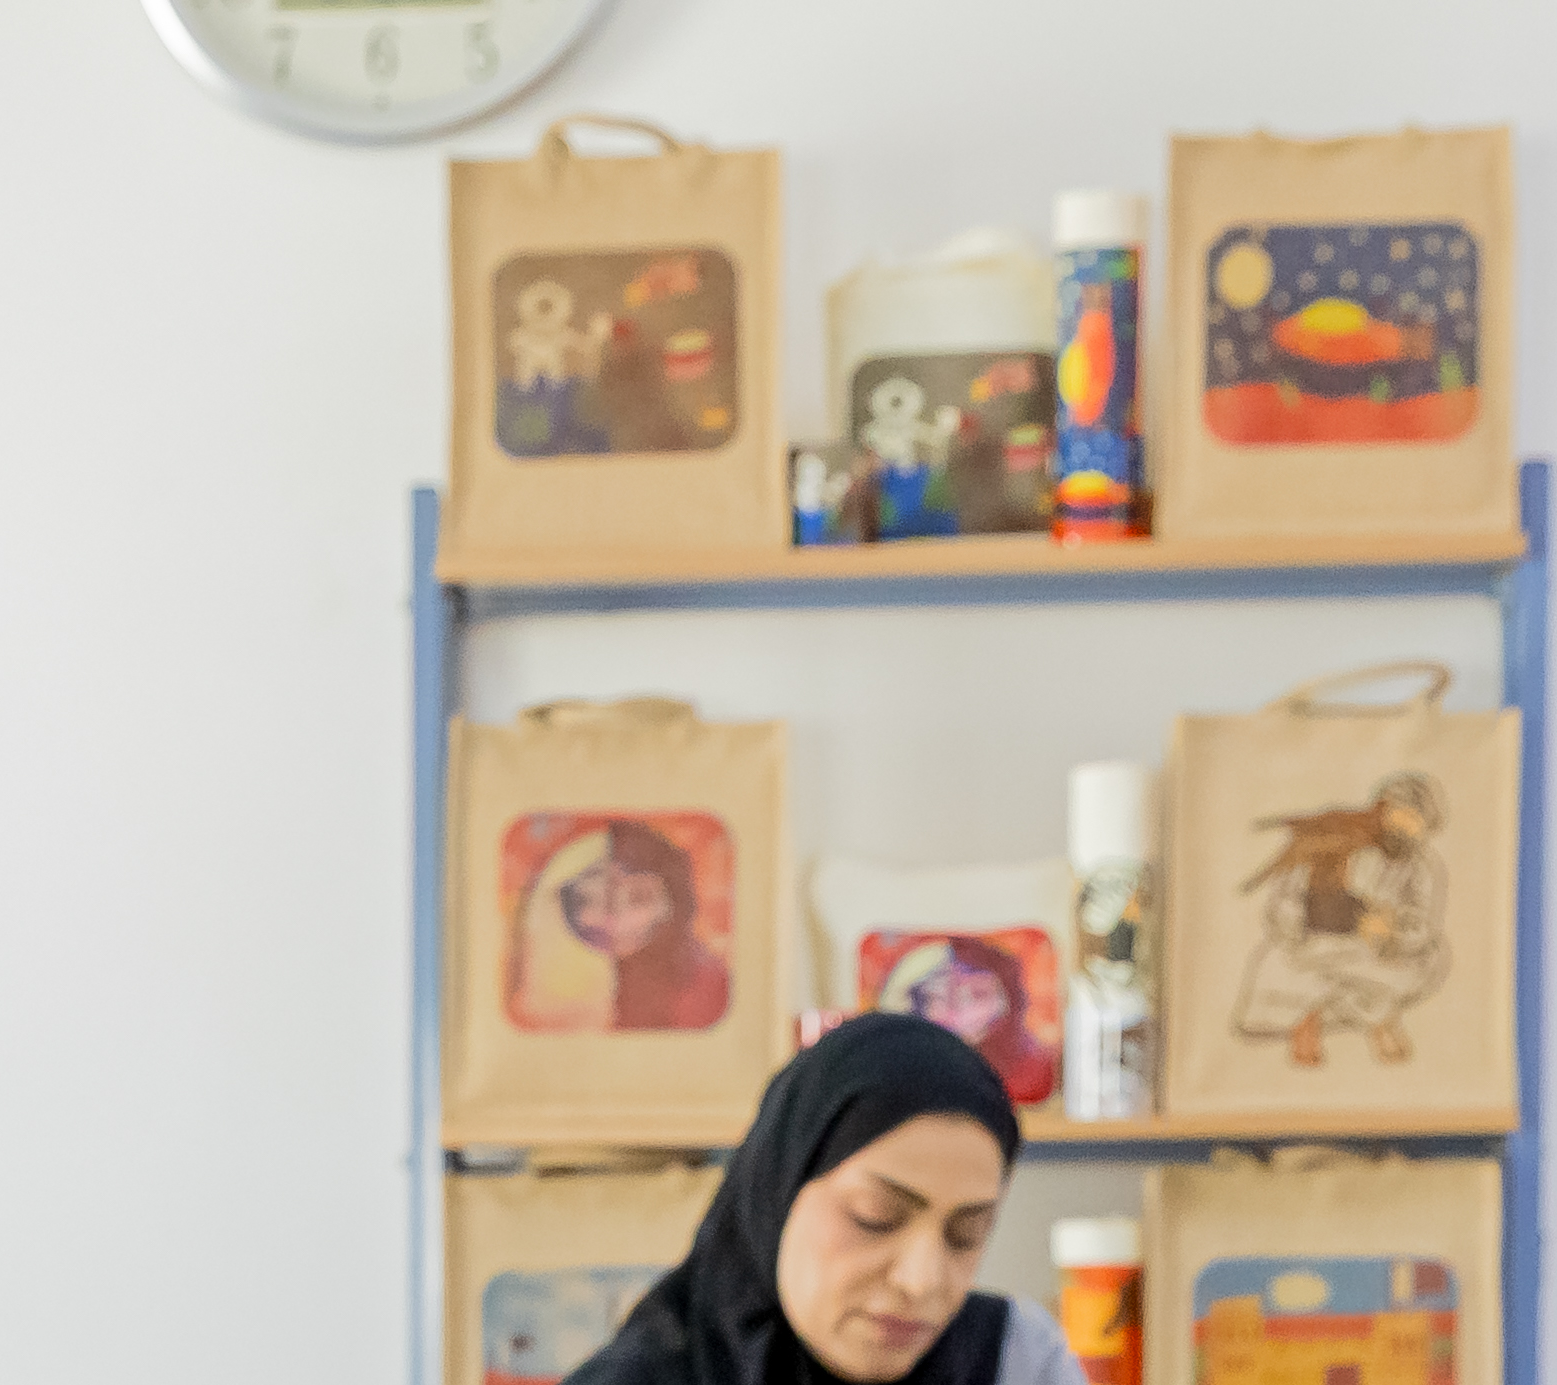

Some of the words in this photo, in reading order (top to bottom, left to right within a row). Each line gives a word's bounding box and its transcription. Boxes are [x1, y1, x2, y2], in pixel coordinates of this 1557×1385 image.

[263, 24, 300, 88] 7
[363, 24, 401, 84] 6
[464, 22, 501, 83] 5
